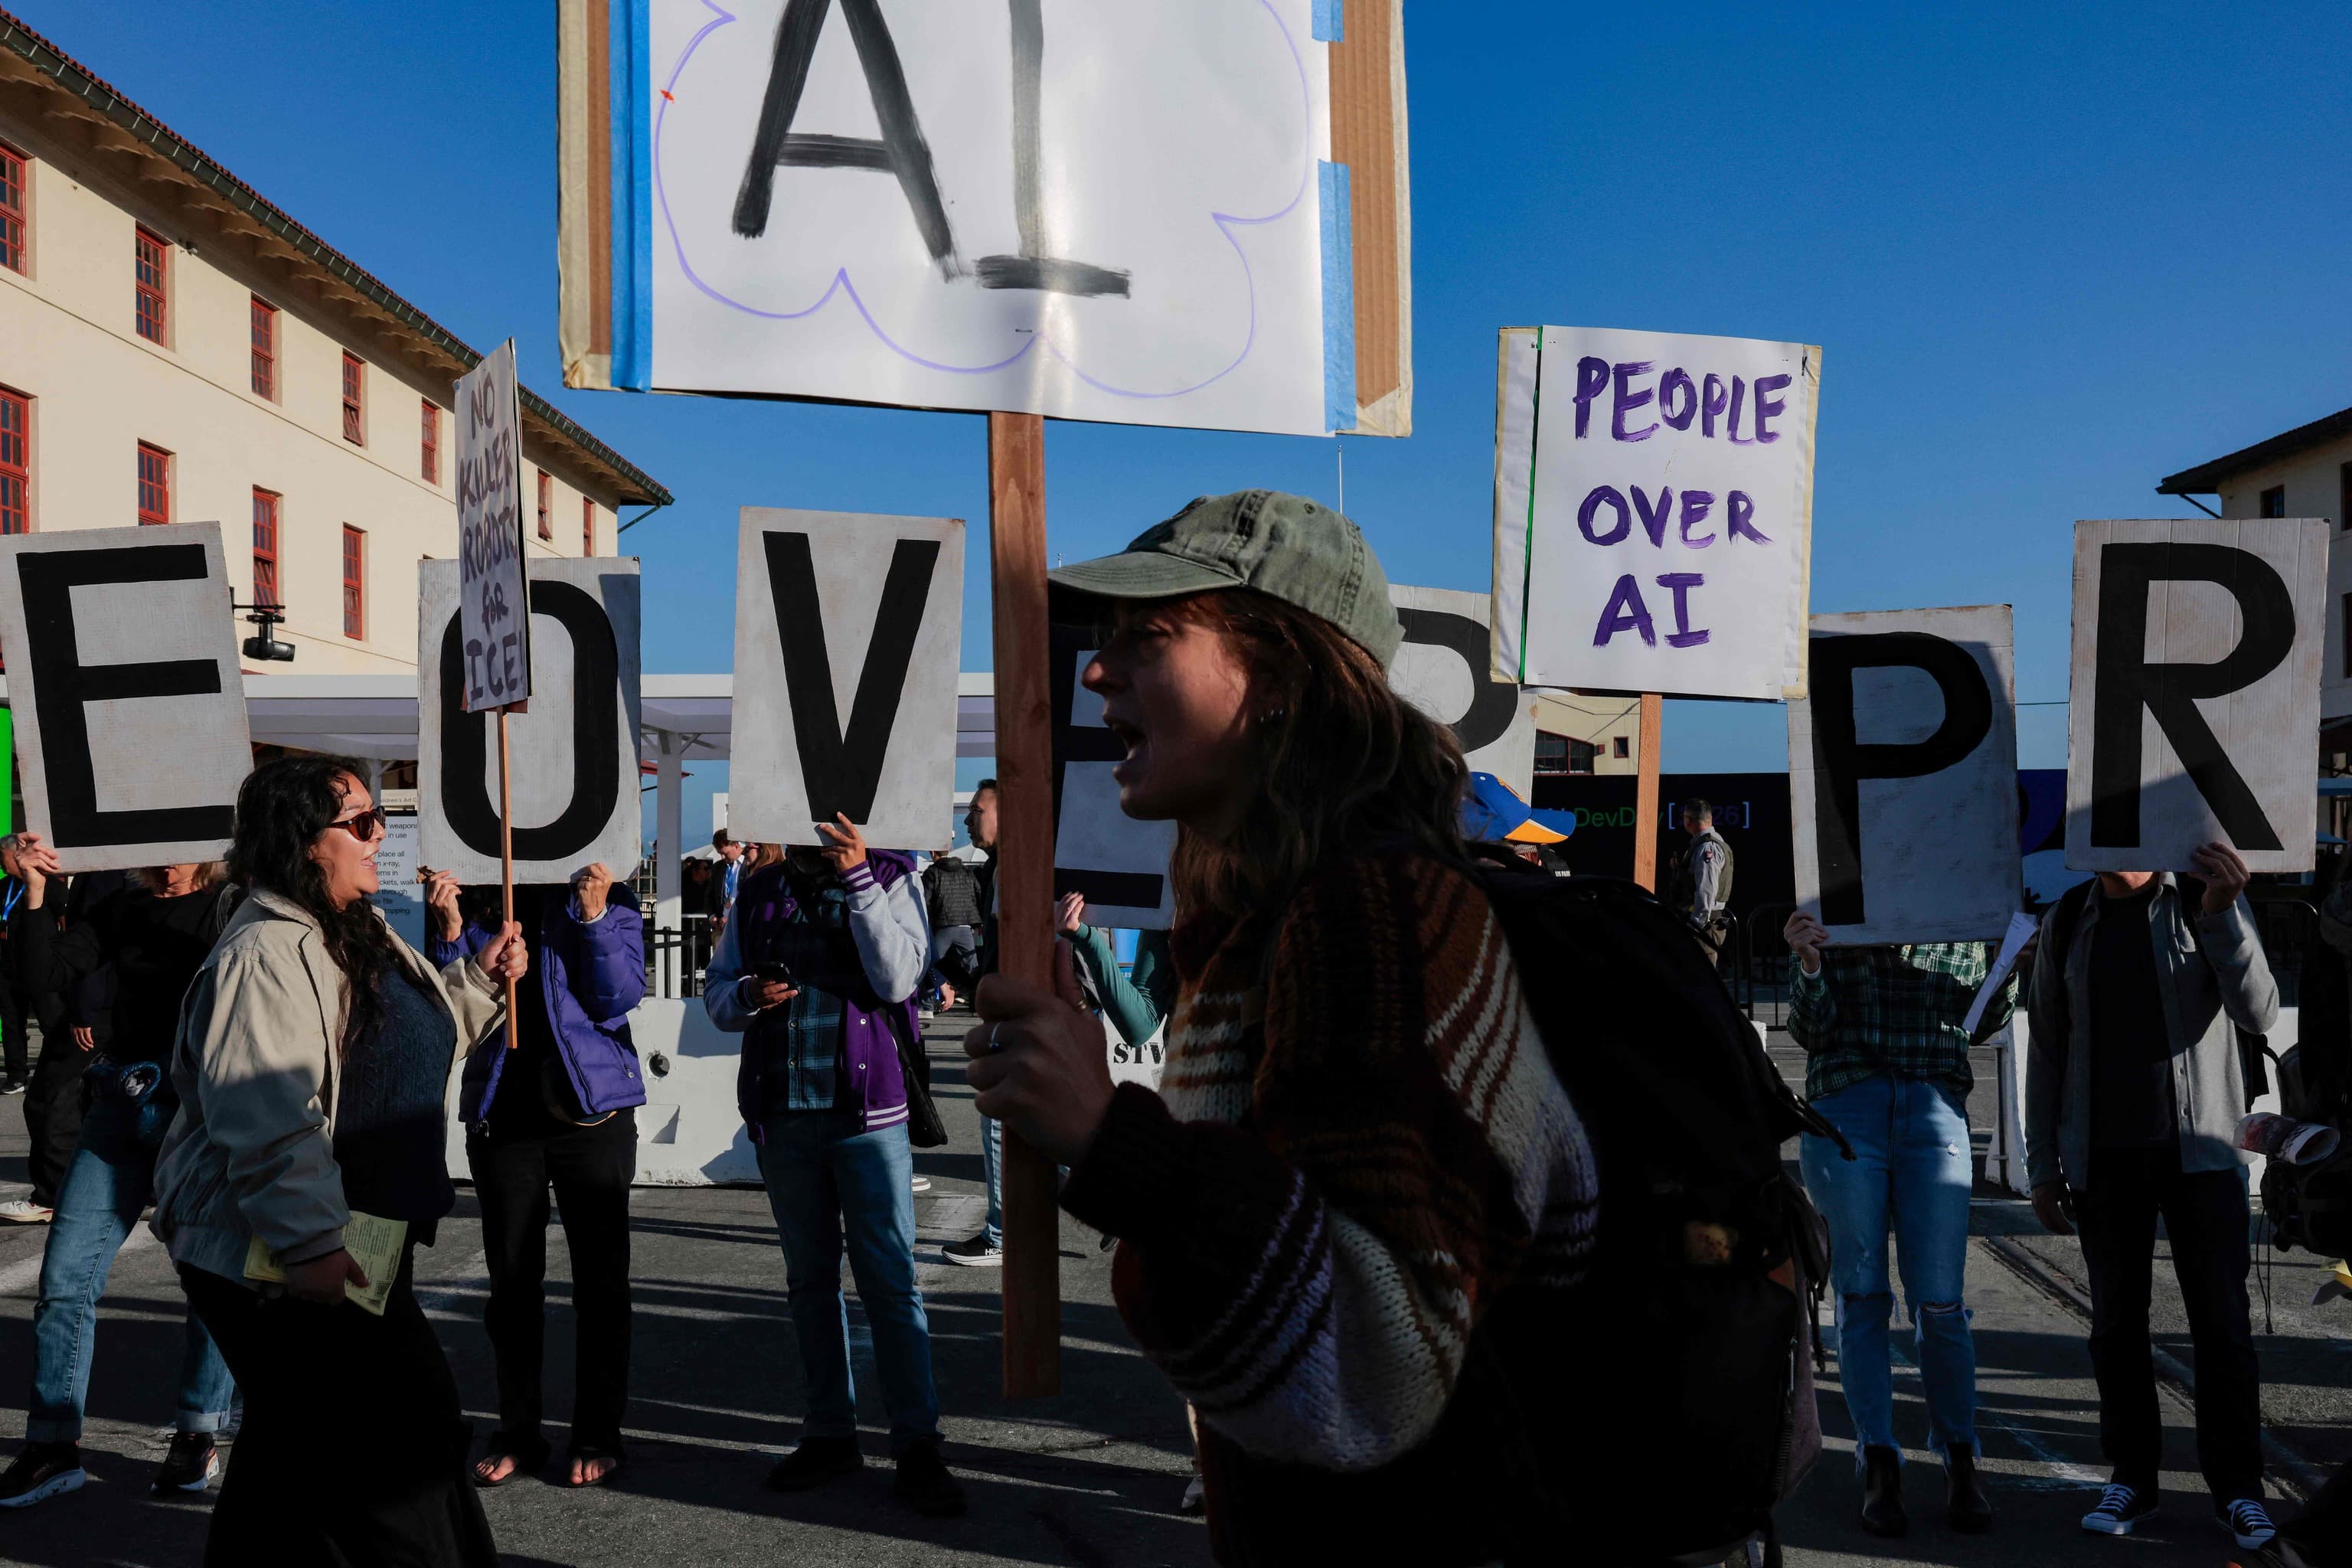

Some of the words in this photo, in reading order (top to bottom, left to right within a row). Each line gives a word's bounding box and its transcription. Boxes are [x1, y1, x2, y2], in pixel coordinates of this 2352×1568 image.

[471, 372, 495, 441] NO
[1573, 355, 1792, 445] PEOPLE
[459, 426, 514, 515] KILLER
[463, 504, 518, 584] ROBOTS
[1576, 484, 1774, 549] OVER
[1592, 572, 1711, 649] AI
[17, 544, 235, 848] E
[466, 629, 524, 702] ICE!
[763, 531, 941, 825] V
[2091, 542, 2296, 851] R
[440, 579, 619, 861] O
[1809, 632, 1993, 926] P
